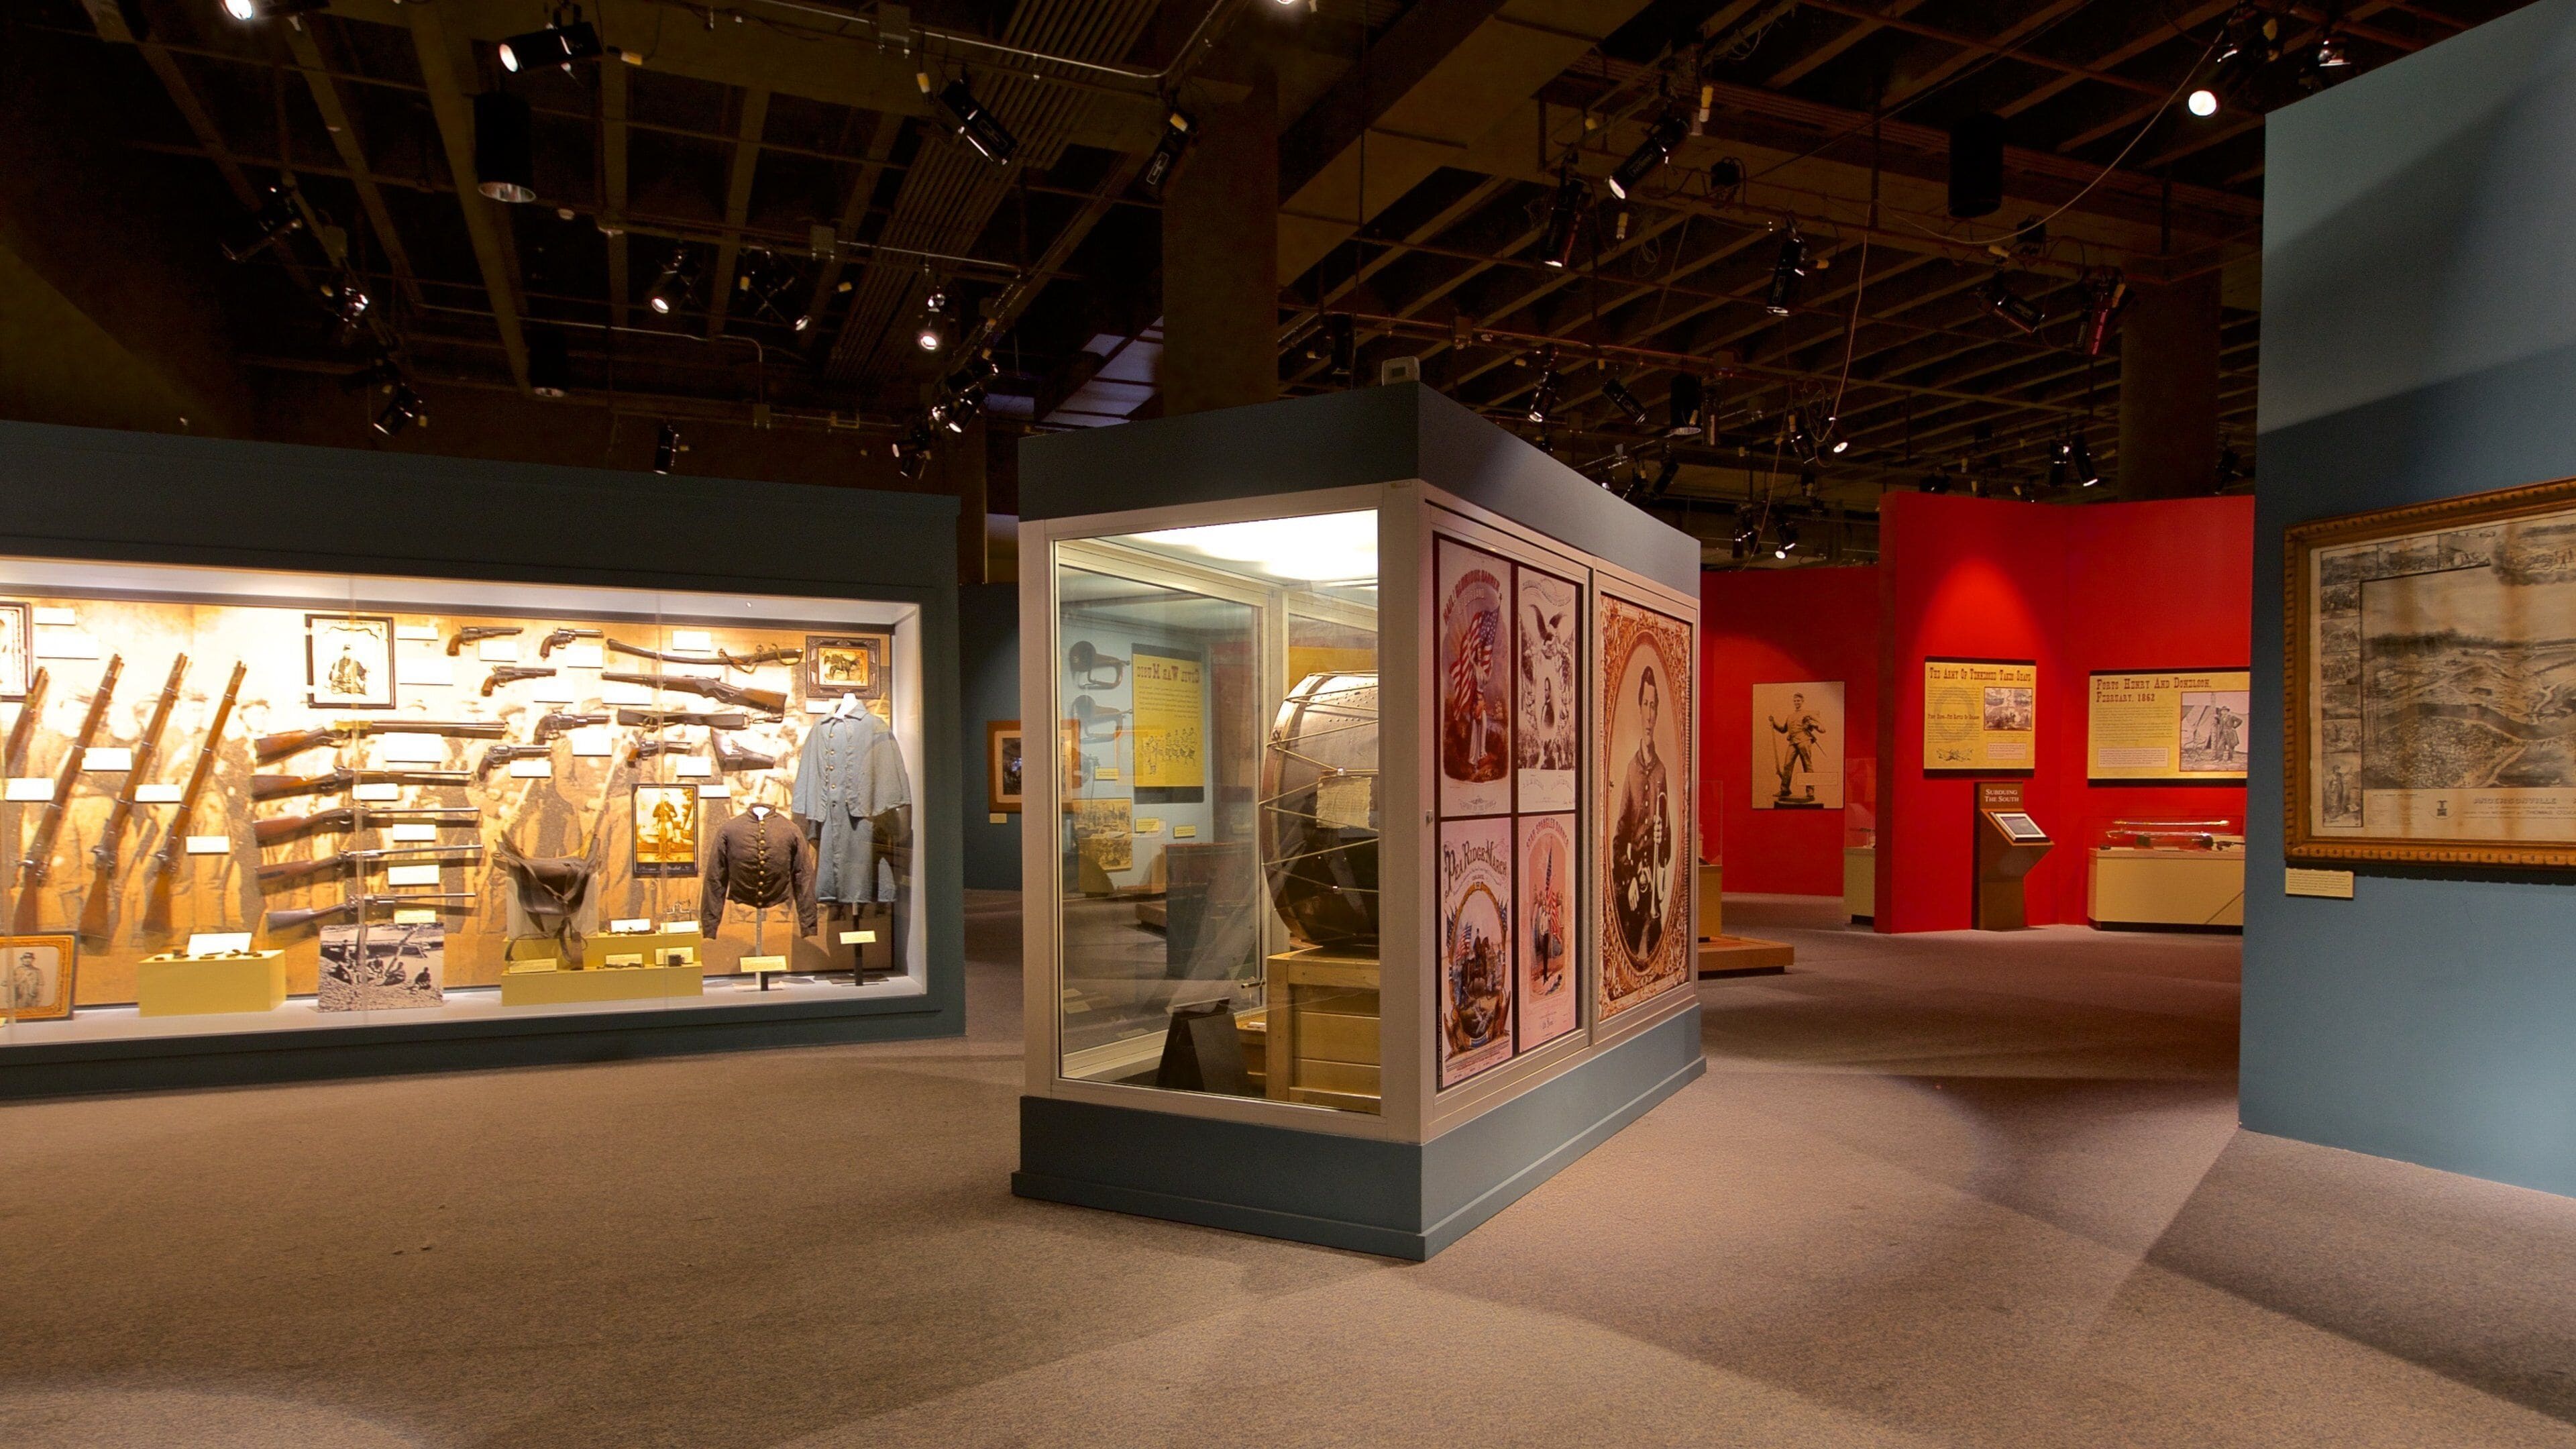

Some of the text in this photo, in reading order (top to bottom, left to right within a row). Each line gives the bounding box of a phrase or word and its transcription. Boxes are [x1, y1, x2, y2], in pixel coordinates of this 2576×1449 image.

[1929, 667, 1940, 679] THE
[1943, 667, 1958, 679] ARMY
[1961, 668, 1968, 680] OF
[2096, 679, 2119, 690] FORTS
[2124, 678, 2150, 690] HENRY
[2154, 678, 2170, 689] AND
[2137, 694, 2155, 702] 1862
[1444, 844, 1463, 898] PEA
[1462, 841, 1485, 872] RIDGE
[1485, 839, 1507, 876] MARCH
